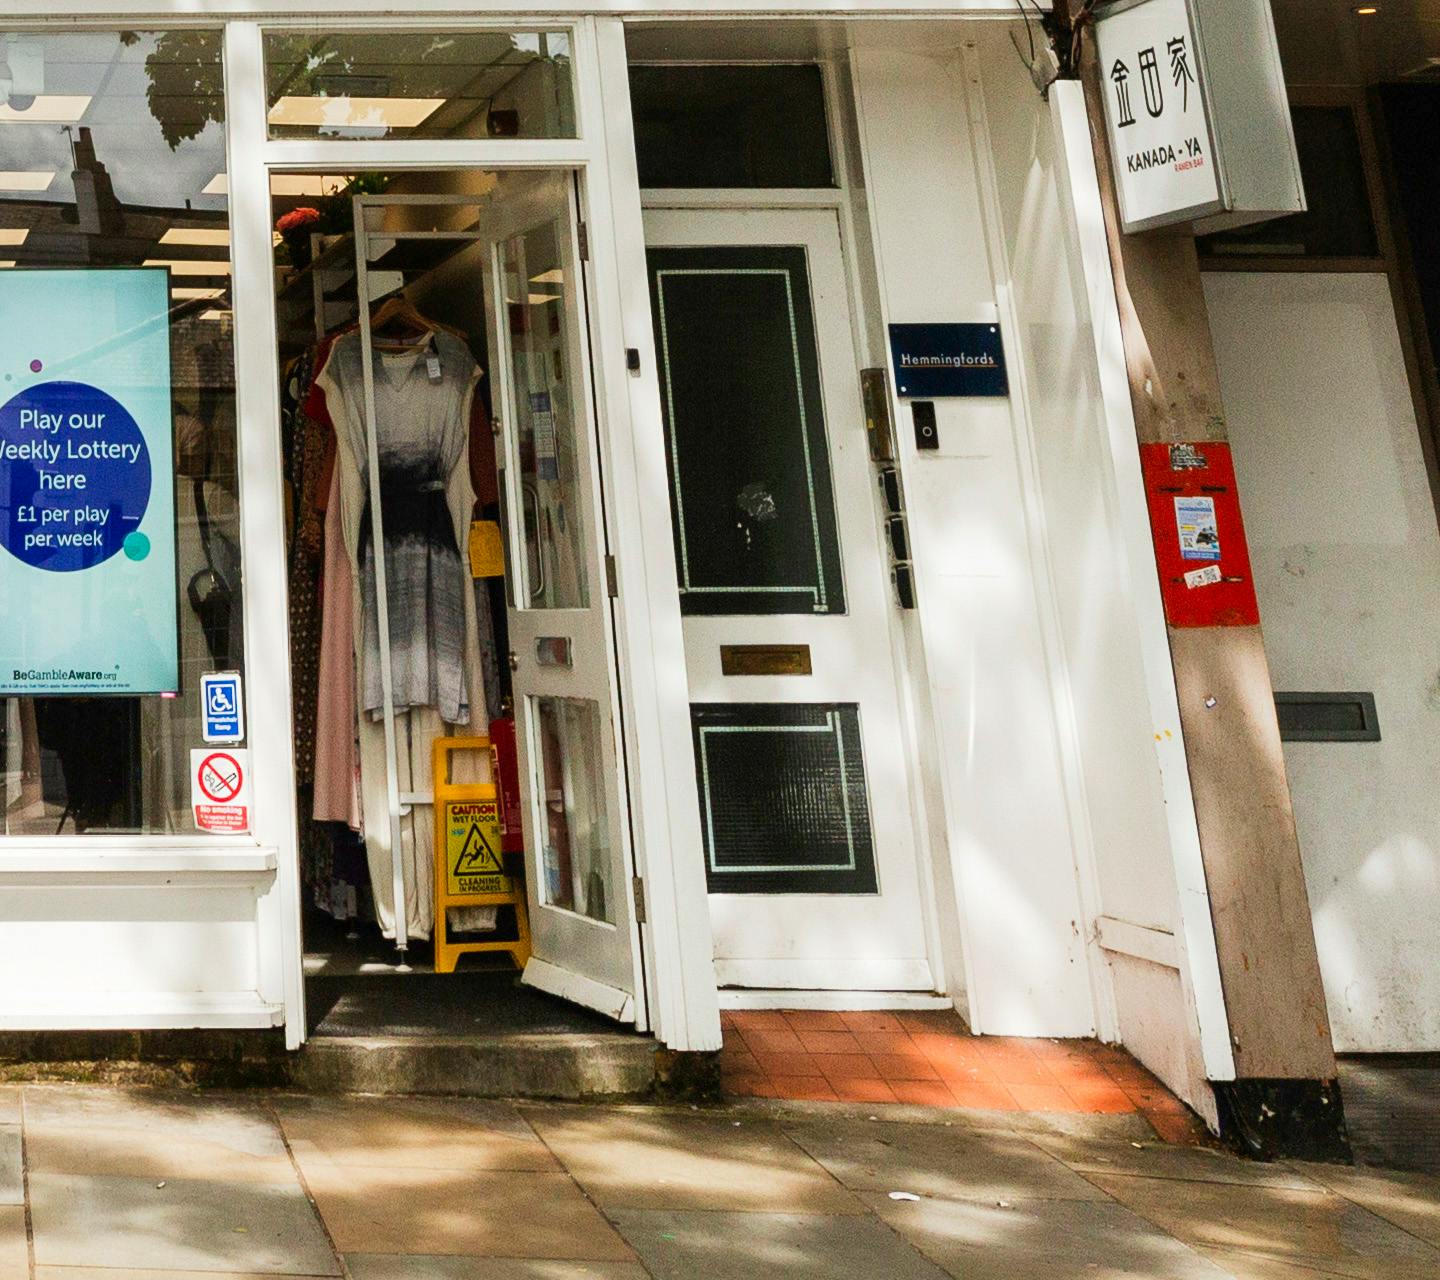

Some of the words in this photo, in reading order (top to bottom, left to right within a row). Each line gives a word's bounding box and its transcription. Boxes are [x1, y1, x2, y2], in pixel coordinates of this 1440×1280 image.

[1126, 144, 1177, 173] KANADA
[1185, 136, 1203, 158] YA
[1174, 160, 1193, 173] RAMEN
[901, 352, 995, 368] Hemmingfords
[20, 409, 63, 434] Play
[68, 413, 106, 429] our
[67, 439, 141, 464] Lottery
[39, 469, 87, 490] here
[17, 505, 37, 523] £1
[41, 508, 69, 526] per
[74, 505, 110, 526] play
[24, 533, 54, 551] per
[56, 529, 103, 547] week
[12, 669, 118, 681] BeGambleAware.org
[451, 804, 496, 815] CAUTION
[452, 815, 469, 823] WET
[470, 815, 497, 823] FLOOR
[459, 877, 501, 886] CLEANING
